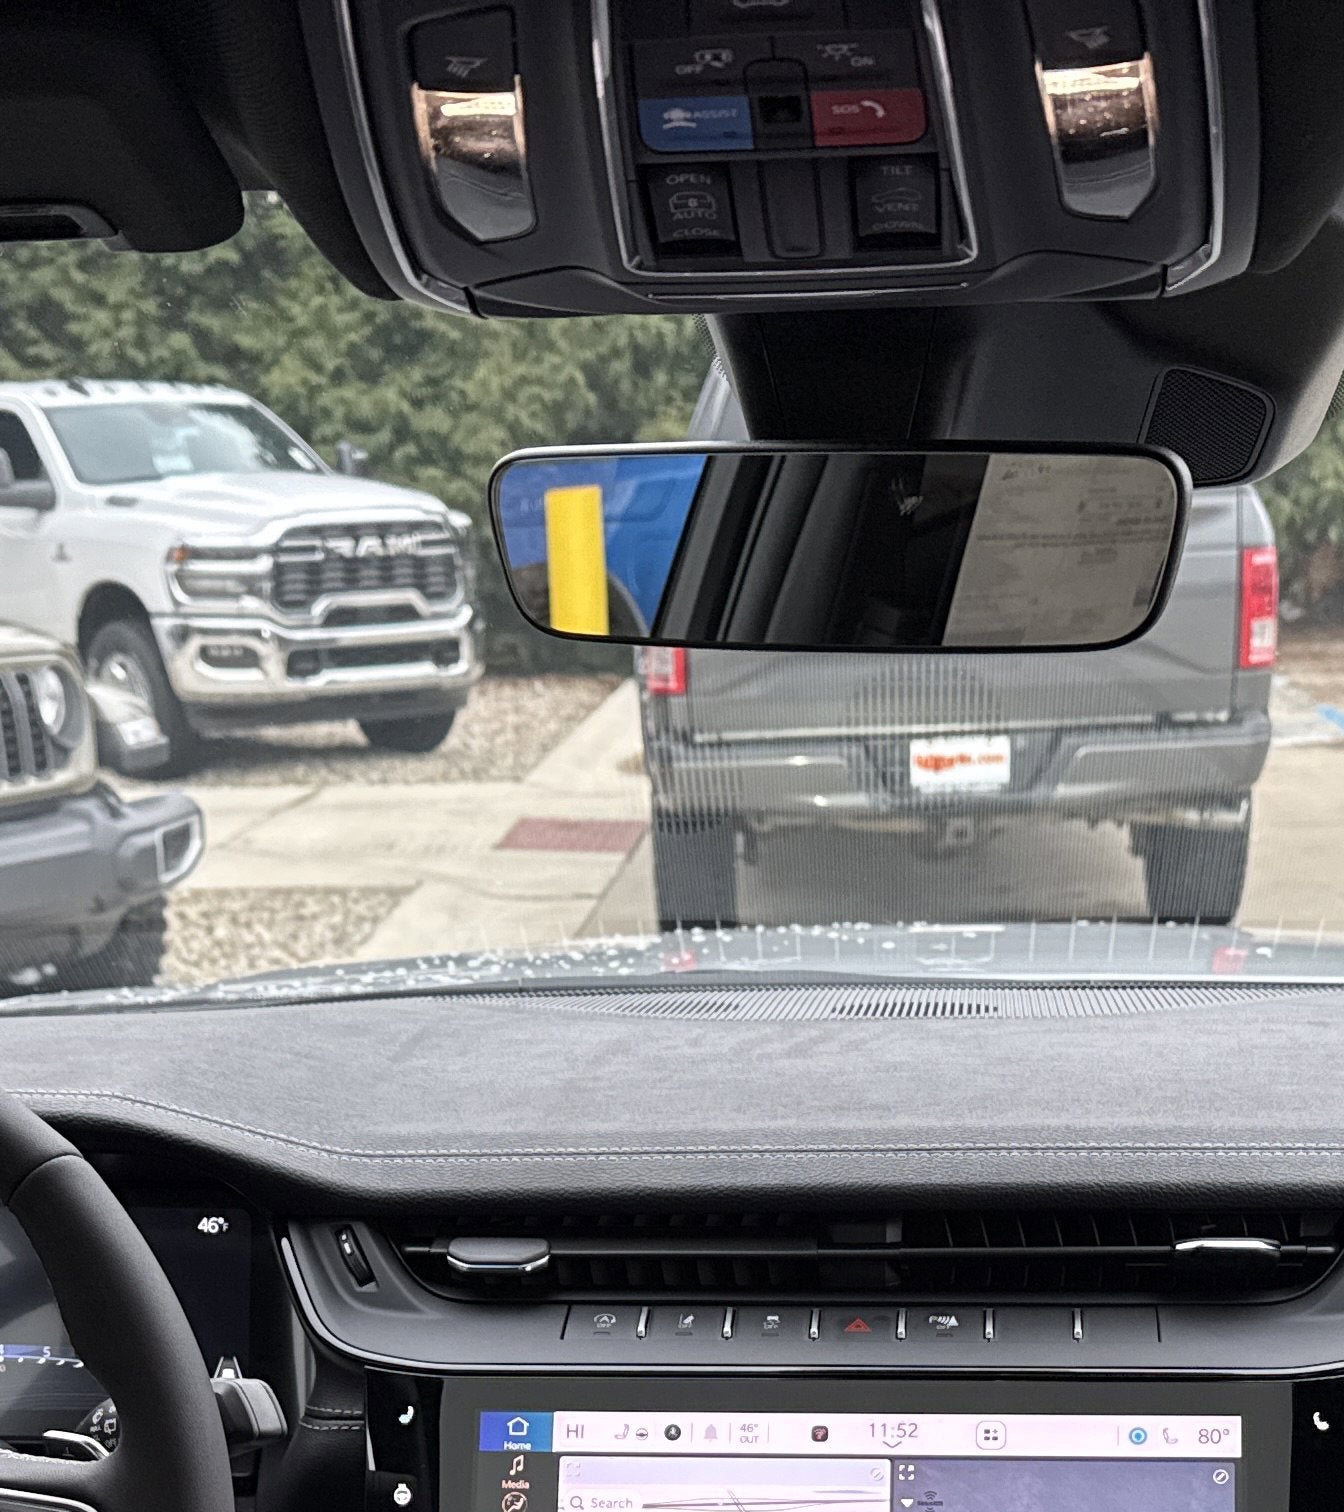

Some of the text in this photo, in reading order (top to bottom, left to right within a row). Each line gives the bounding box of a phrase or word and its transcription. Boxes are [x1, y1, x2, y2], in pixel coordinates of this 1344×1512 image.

[831, 104, 860, 115] SOS
[666, 173, 712, 186] OPEN
[42, 1345, 51, 1358] 5
[565, 1424, 585, 1440] HI
[868, 1422, 919, 1439] 11:52
[1198, 1428, 1230, 1444] 80°
[503, 1440, 532, 1451] Home
[739, 1434, 760, 1445] OUT
[501, 1479, 530, 1490] Media
[590, 1497, 633, 1510] Search
